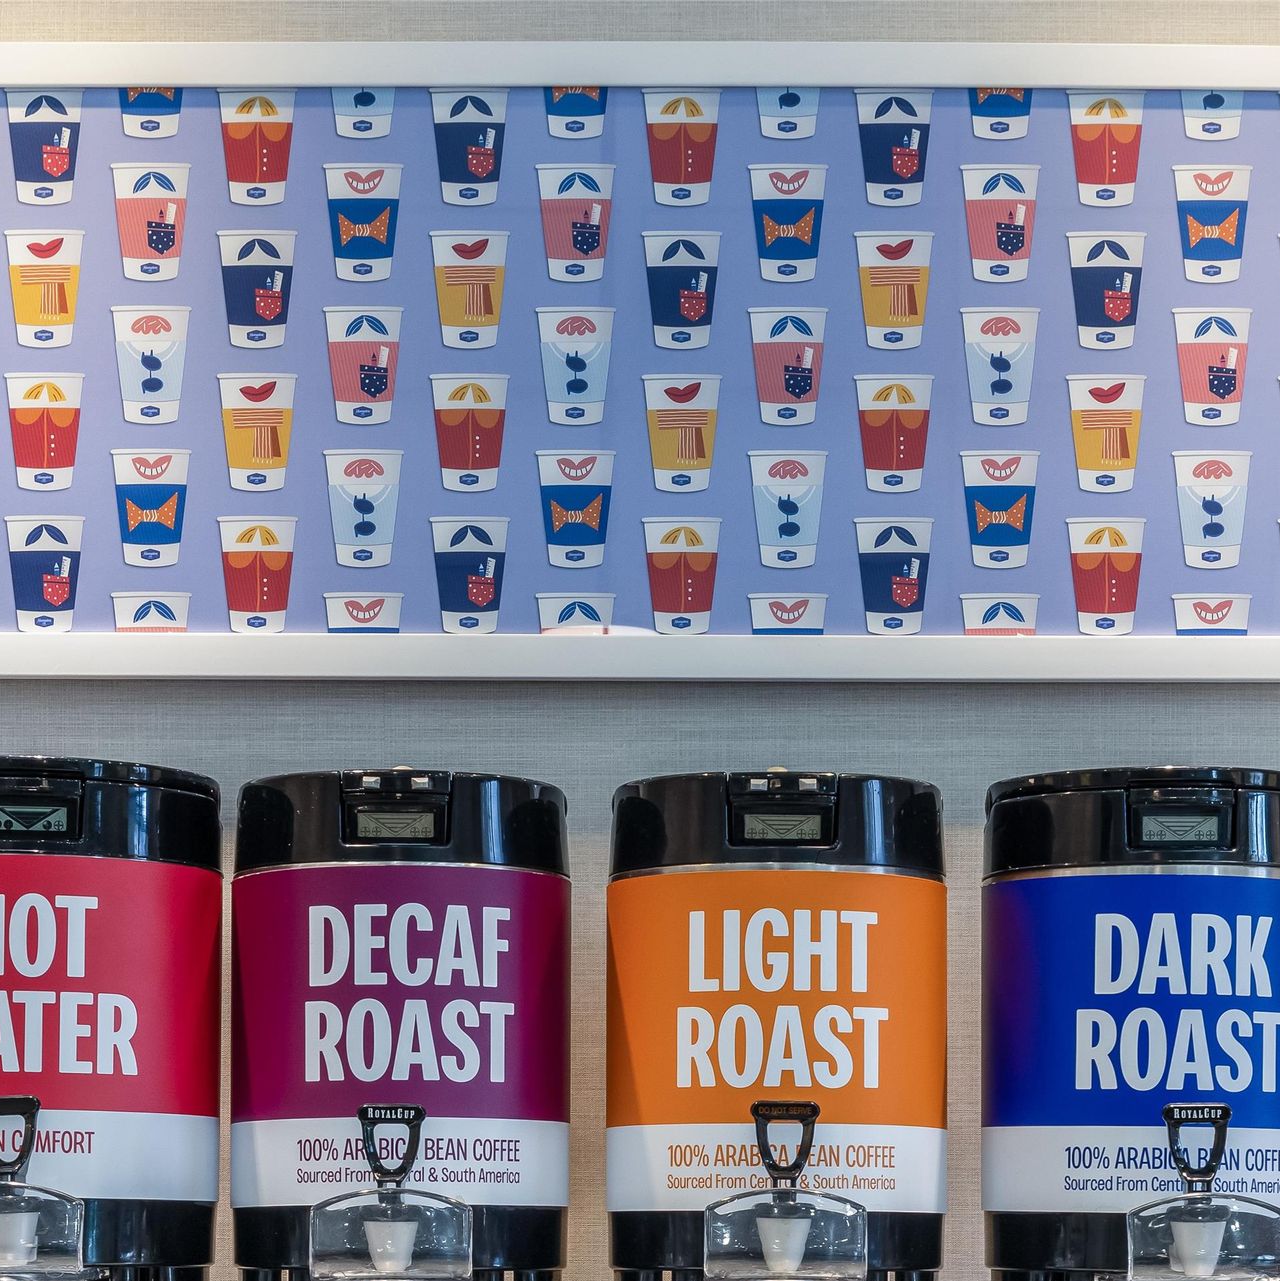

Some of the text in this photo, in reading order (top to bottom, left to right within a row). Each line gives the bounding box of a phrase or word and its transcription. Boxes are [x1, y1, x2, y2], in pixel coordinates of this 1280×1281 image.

[309, 903, 511, 987] DECAF
[688, 907, 878, 993] LIGHT
[1092, 912, 1275, 998] DARK
[304, 999, 515, 1083] ROAST
[675, 1003, 889, 1089] ROAST
[12, 1130, 95, 1153] CMFORT
[297, 1138, 520, 1162] 100% ARBIC BEAN COFFEE
[667, 1144, 709, 1167] 100%
[846, 1145, 895, 1168] COFFEE
[1064, 1147, 1110, 1169] 100%
[1198, 1148, 1240, 1171] BAN
[297, 1168, 342, 1183] Sourced
[345, 1168, 374, 1183] From
[429, 1169, 438, 1182] &
[441, 1168, 476, 1183] South
[479, 1168, 520, 1184] America
[667, 1174, 712, 1189] Sourced
[715, 1174, 746, 1189] From
[800, 1175, 810, 1189] &
[813, 1174, 848, 1190] South
[851, 1175, 896, 1190] America
[1064, 1176, 1113, 1191] Sourced
[1116, 1177, 1148, 1191] From
[1214, 1178, 1247, 1193] South
